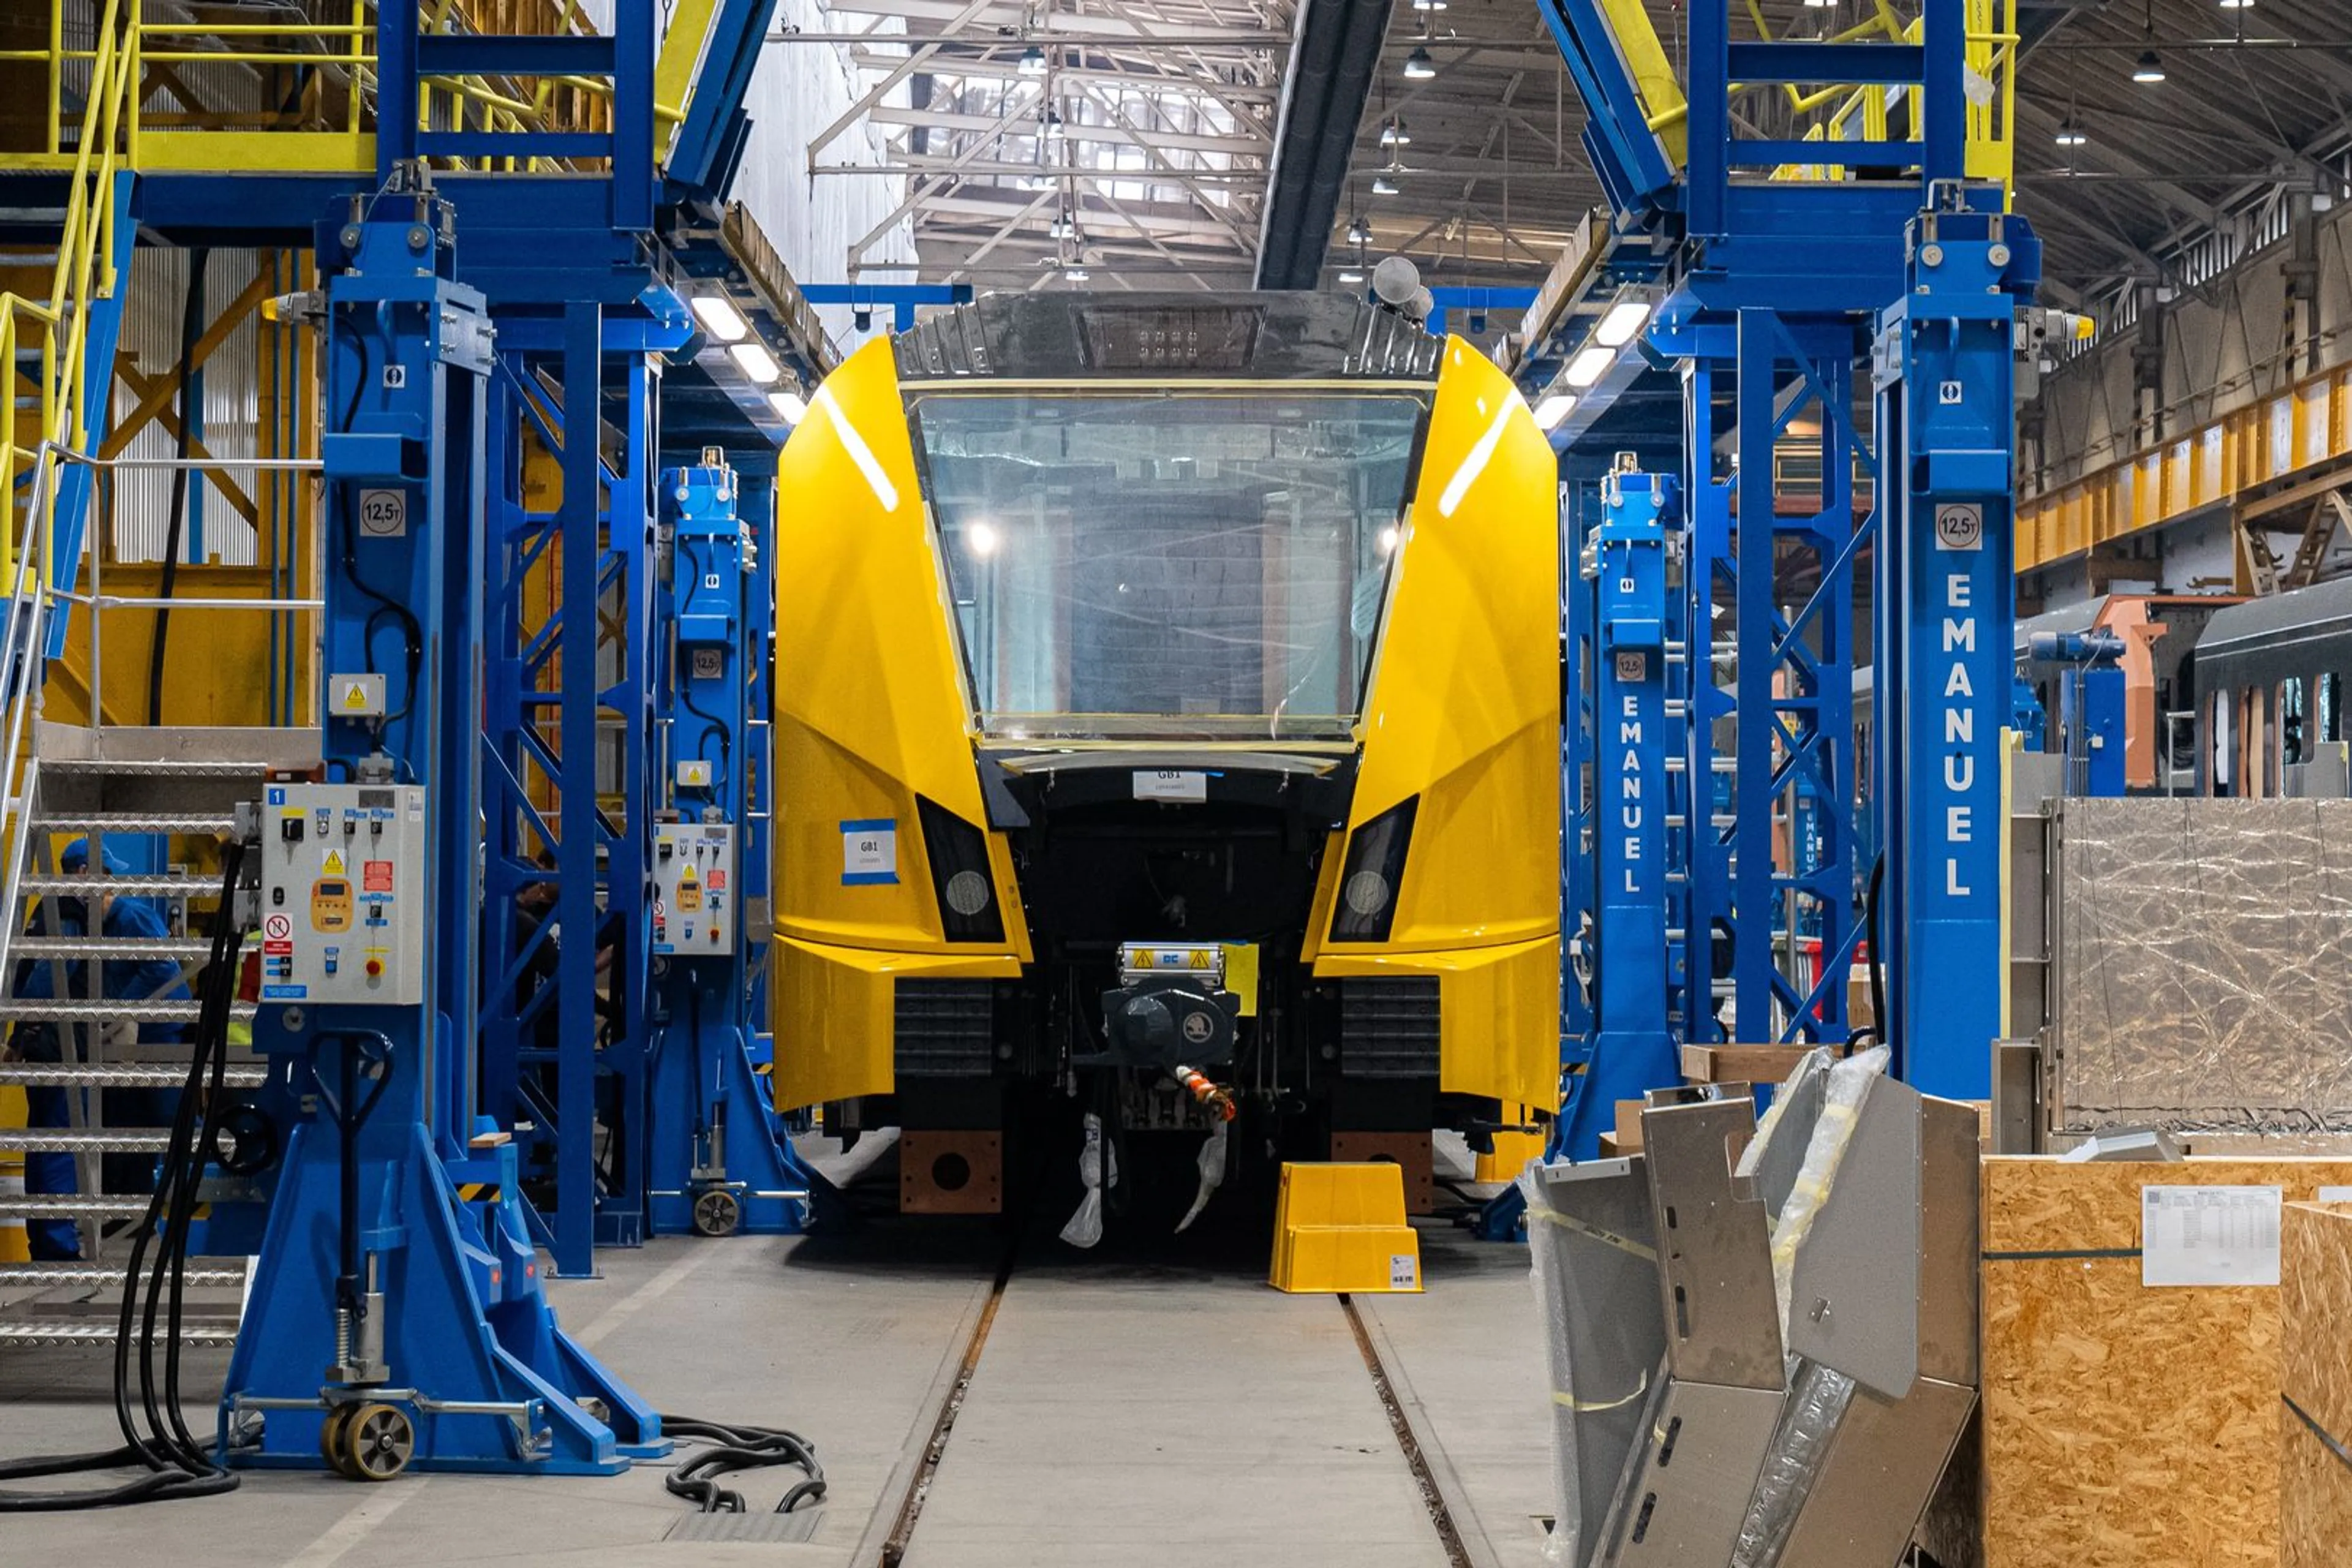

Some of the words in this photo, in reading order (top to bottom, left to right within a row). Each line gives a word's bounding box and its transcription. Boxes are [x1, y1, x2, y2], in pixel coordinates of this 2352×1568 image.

[1943, 574, 1976, 895] EMANUEL
[274, 791, 281, 804] 1
[1621, 696, 1642, 892] EMANUEL
[861, 841, 878, 852] GB1
[1163, 954, 1179, 964] DC
